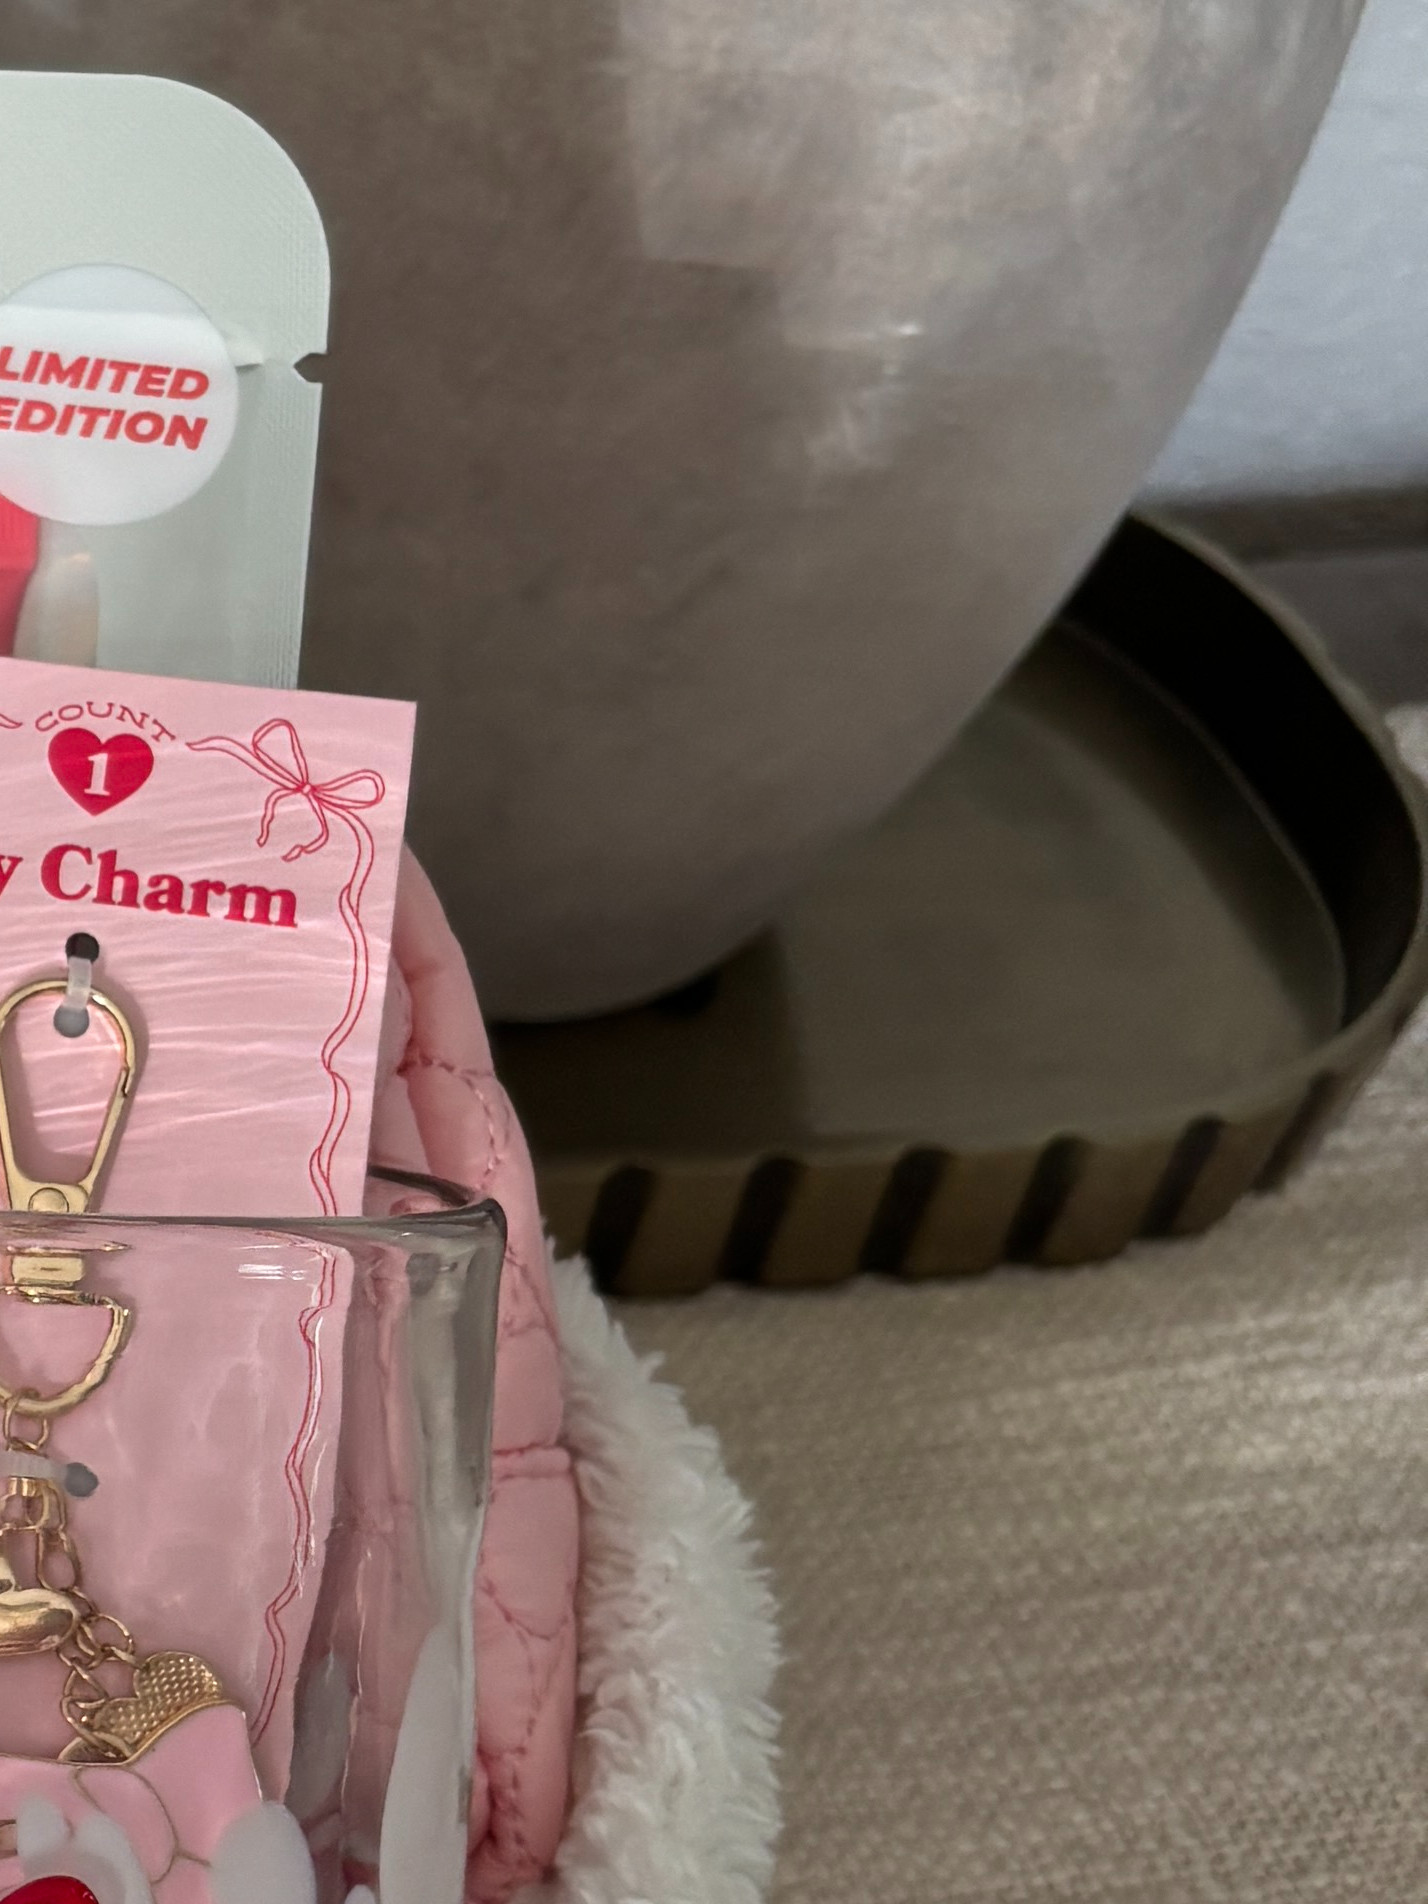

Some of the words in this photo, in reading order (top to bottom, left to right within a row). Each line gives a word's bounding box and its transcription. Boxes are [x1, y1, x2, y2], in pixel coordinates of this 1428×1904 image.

[35, 701, 176, 742] COUNT
[84, 752, 111, 796] 1
[39, 841, 300, 930] Charm
